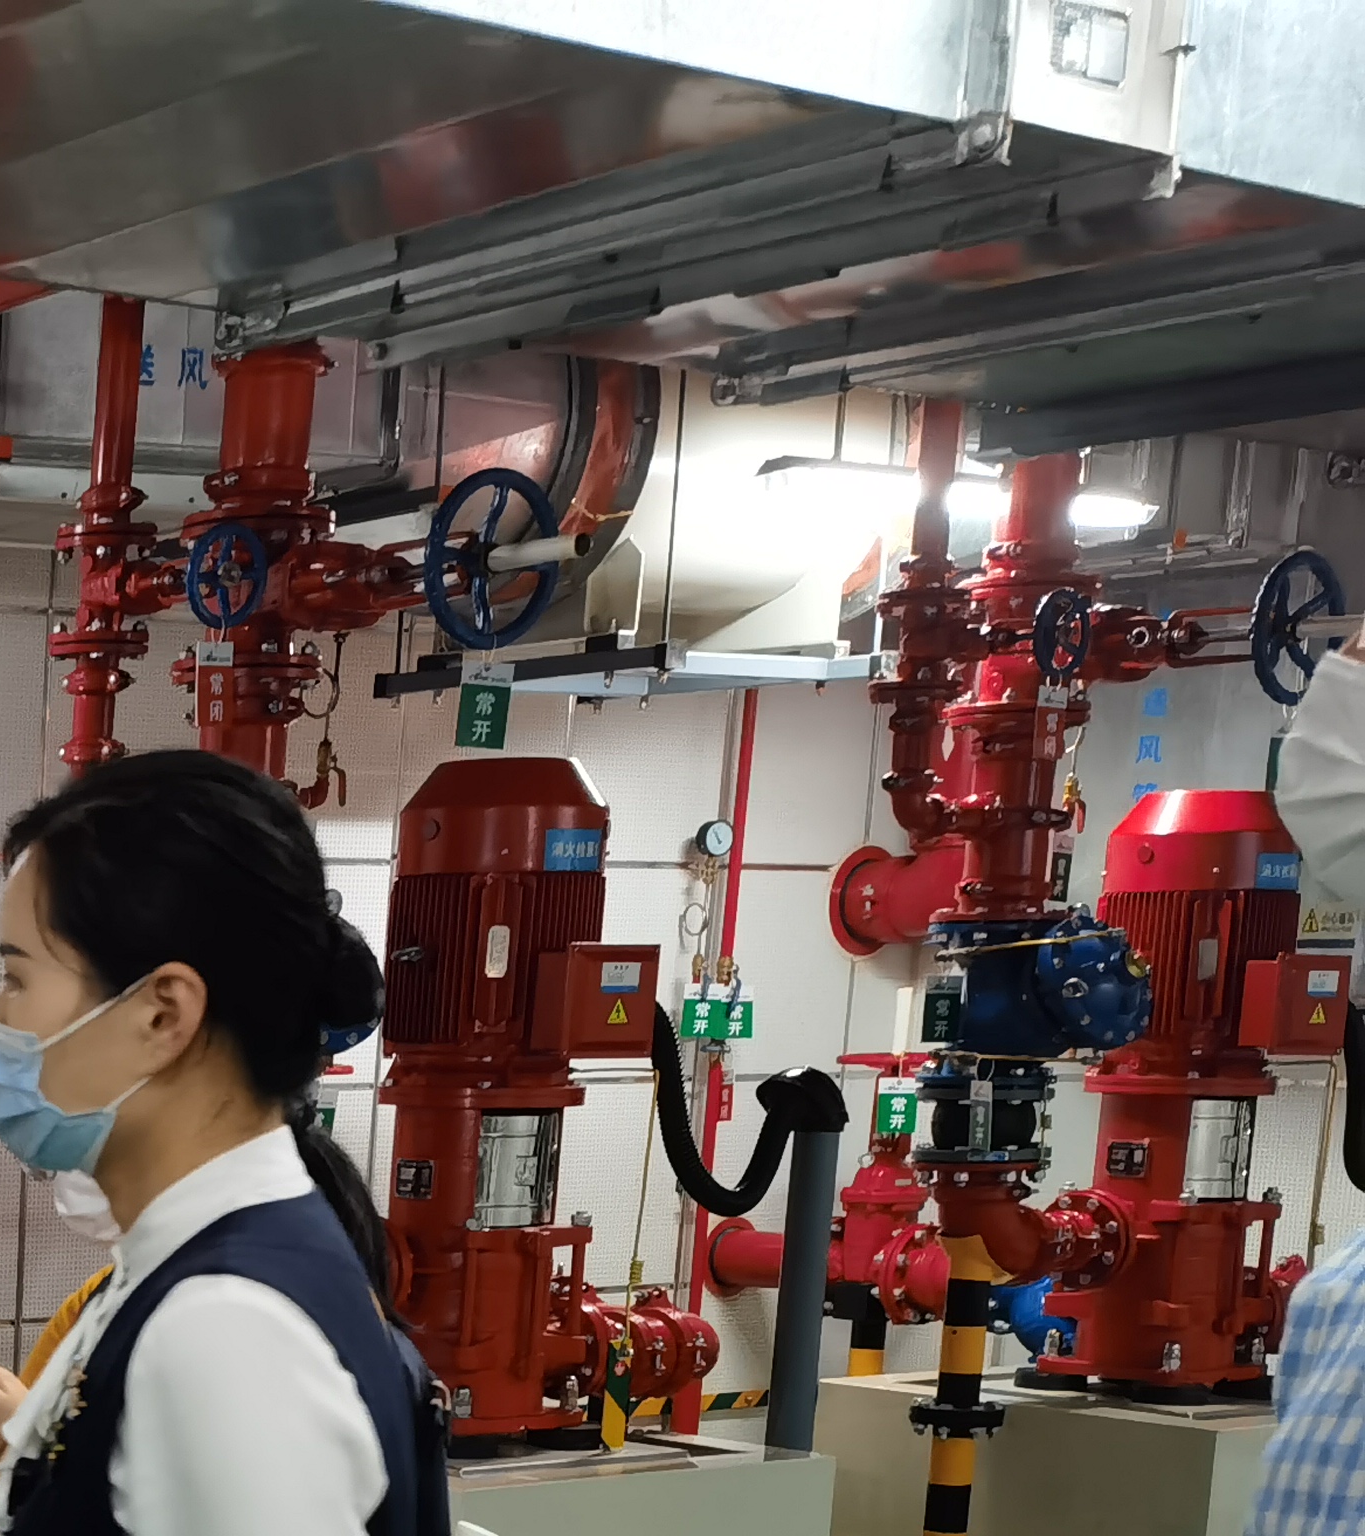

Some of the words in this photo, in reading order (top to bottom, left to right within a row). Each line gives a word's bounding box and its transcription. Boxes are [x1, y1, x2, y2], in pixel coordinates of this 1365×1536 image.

[471, 691, 496, 743] 常开
[692, 1002, 711, 1035] 常开
[889, 1096, 907, 1130] 常开
